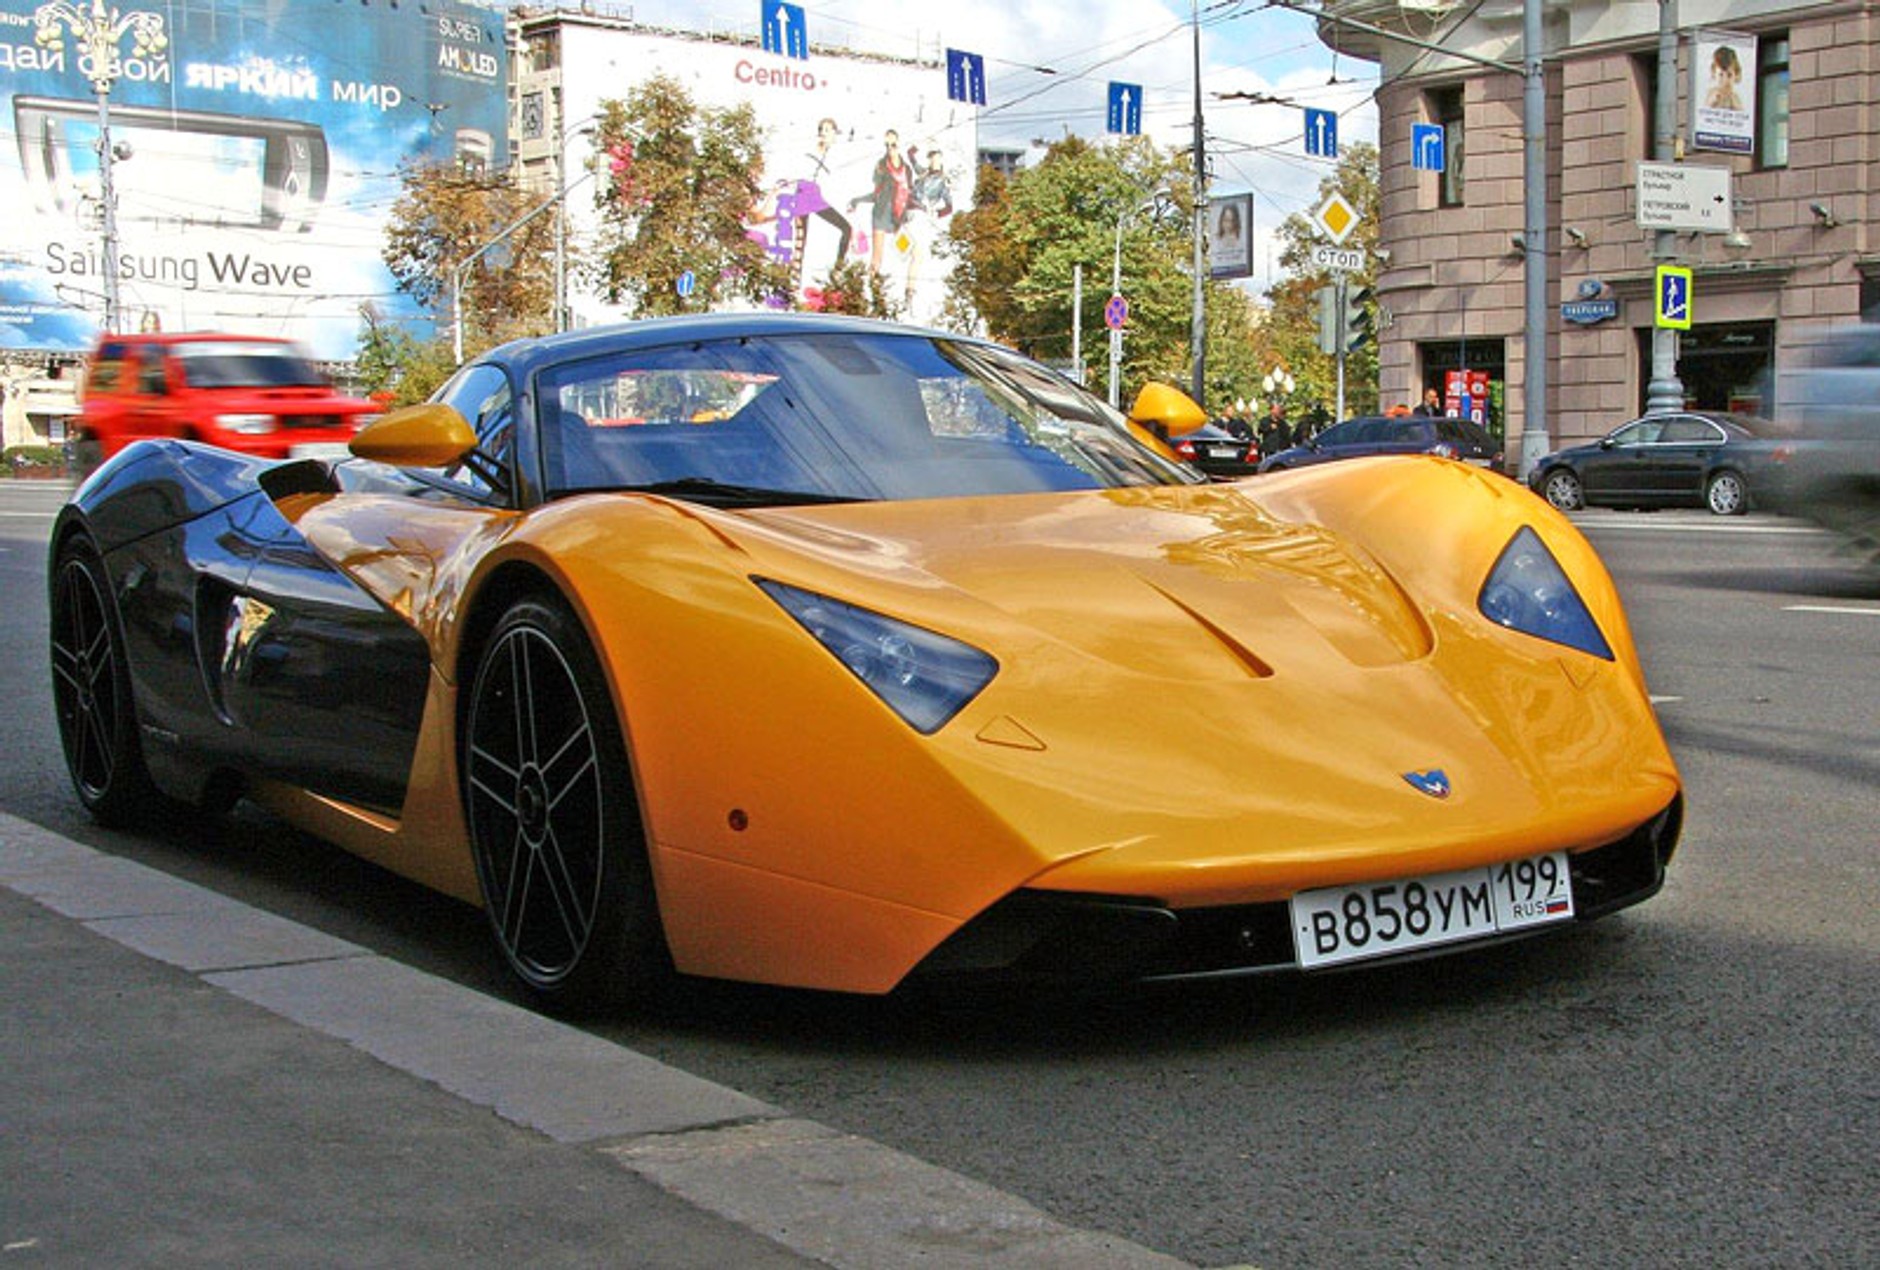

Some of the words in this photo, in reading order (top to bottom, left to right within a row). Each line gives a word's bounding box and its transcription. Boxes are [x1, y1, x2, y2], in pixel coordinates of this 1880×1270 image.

[332, 80, 401, 111] мир
[207, 251, 312, 287] Wave
[1318, 249, 1360, 267] СТОП
[1497, 856, 1558, 902] 199
[1513, 901, 1545, 918] RUS
